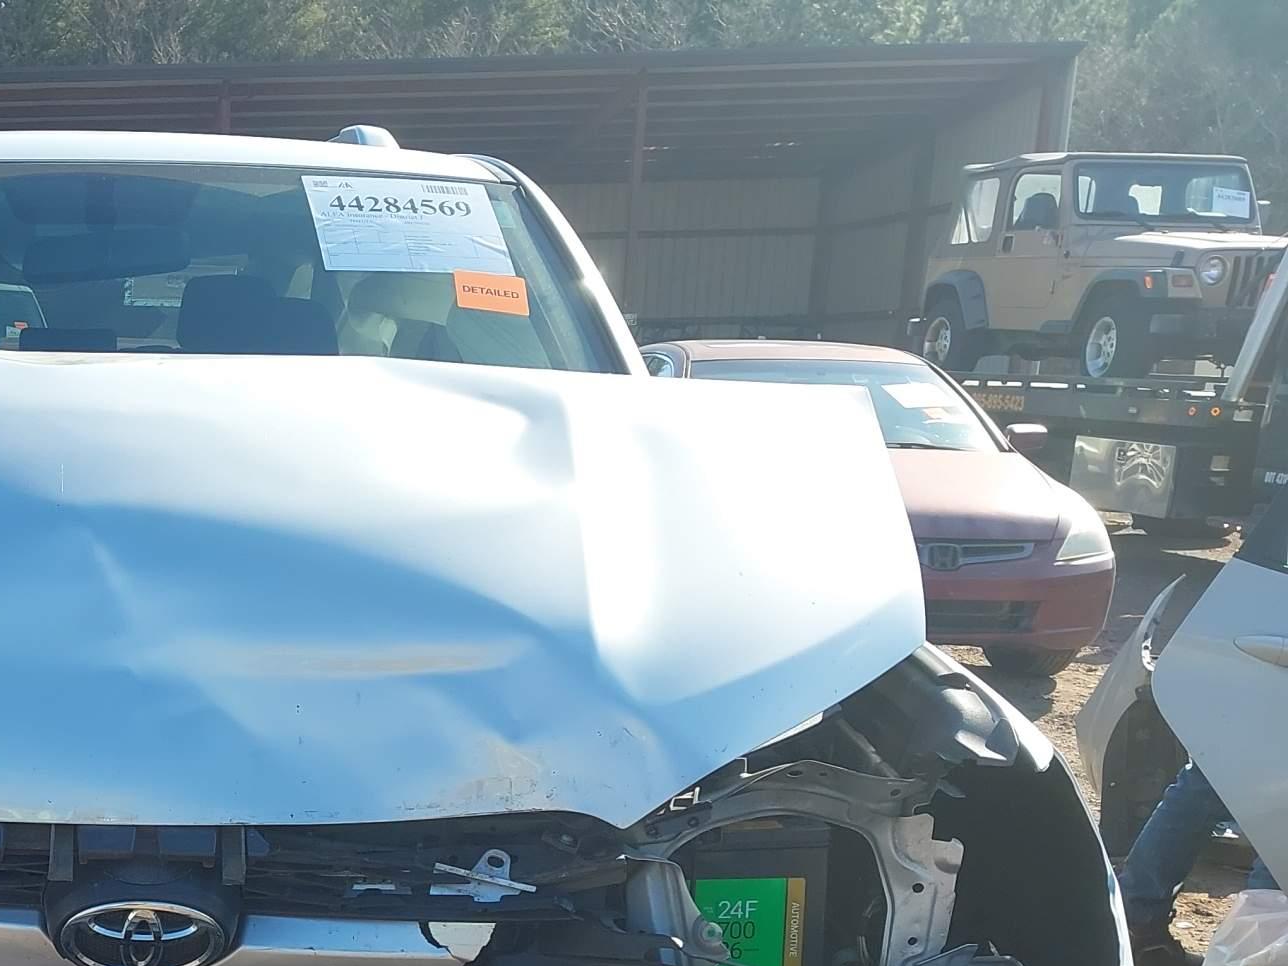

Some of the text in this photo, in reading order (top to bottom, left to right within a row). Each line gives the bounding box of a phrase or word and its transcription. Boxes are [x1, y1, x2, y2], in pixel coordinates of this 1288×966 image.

[329, 195, 472, 217] 44284569
[462, 284, 519, 299] DETAILED
[718, 900, 758, 919] 24F
[718, 921, 755, 939] 700
[789, 902, 800, 957] AUTOMOTIVE
